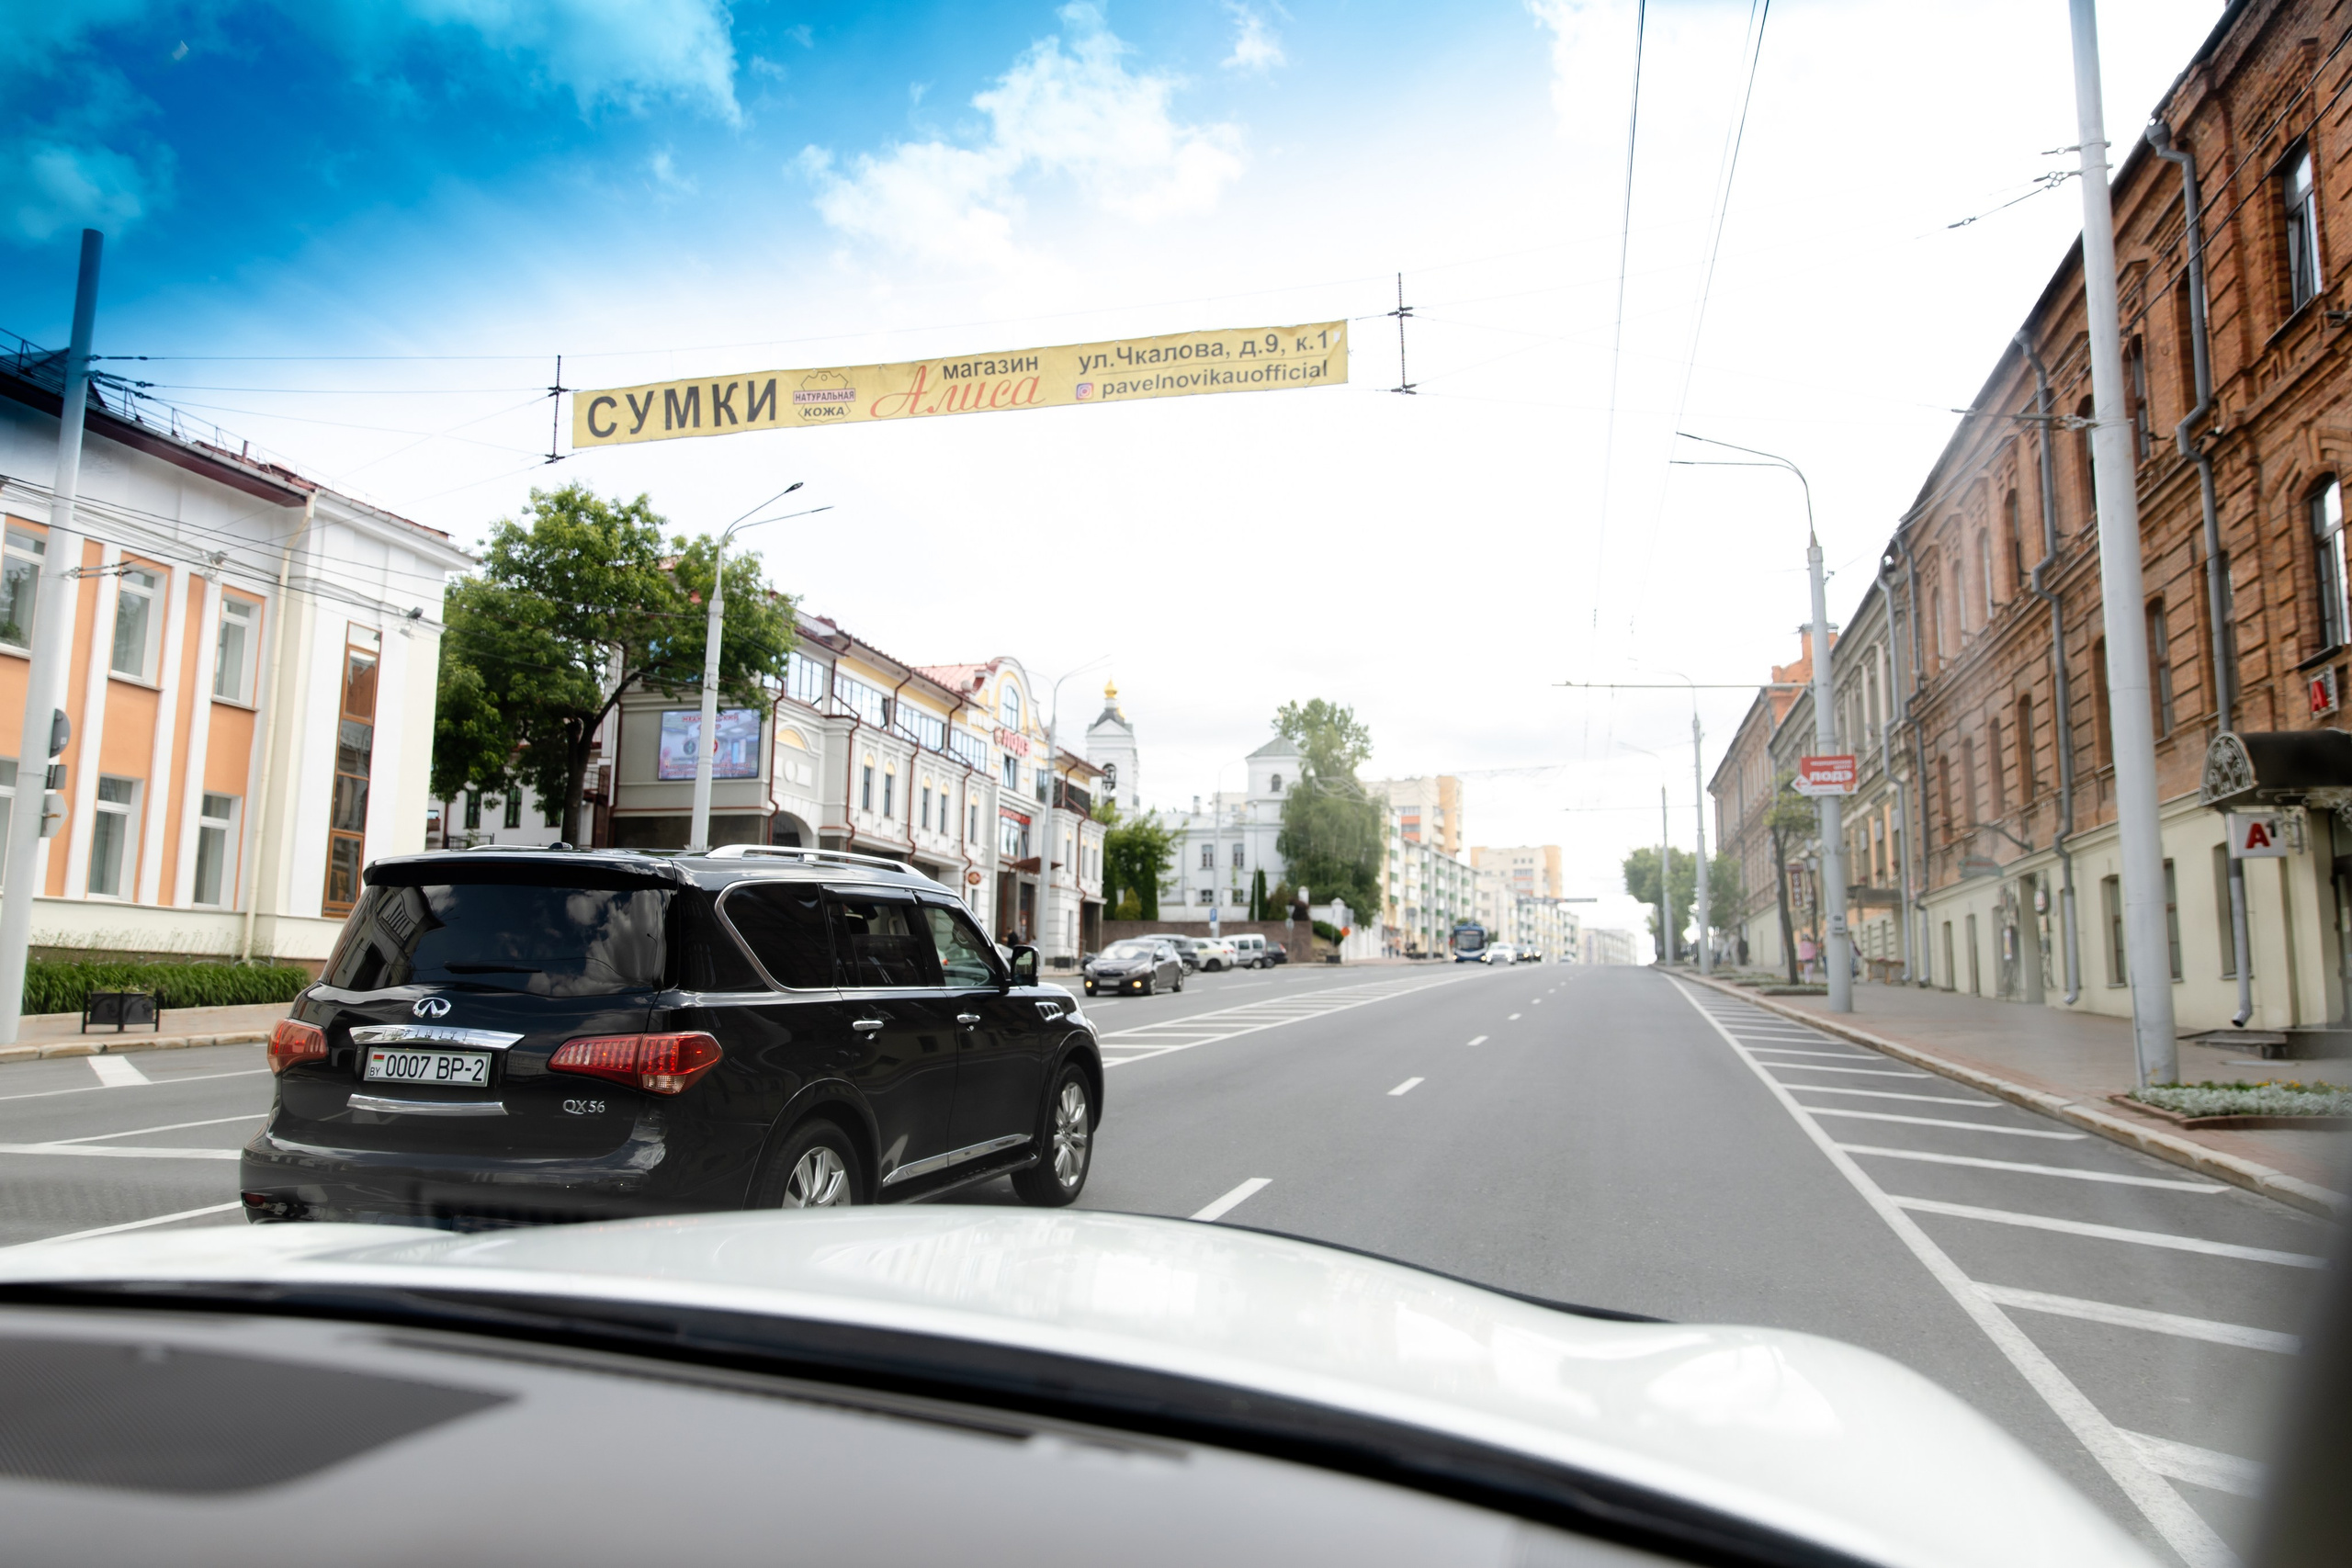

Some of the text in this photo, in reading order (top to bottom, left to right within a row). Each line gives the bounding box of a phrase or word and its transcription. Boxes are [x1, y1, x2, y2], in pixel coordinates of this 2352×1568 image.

[1238, 333, 1286, 359] д.9,
[1295, 330, 1329, 353] к.1
[943, 355, 1040, 380] магазин
[1102, 358, 1329, 400] pavelnovikauofficial
[794, 389, 855, 403] НАТУРАЛЬНАЯ
[870, 364, 1046, 419] Алиса
[586, 378, 777, 439] СУМКИ
[803, 405, 846, 418] КОЖА
[369, 1066, 381, 1077] BY
[385, 1054, 432, 1079] 0007
